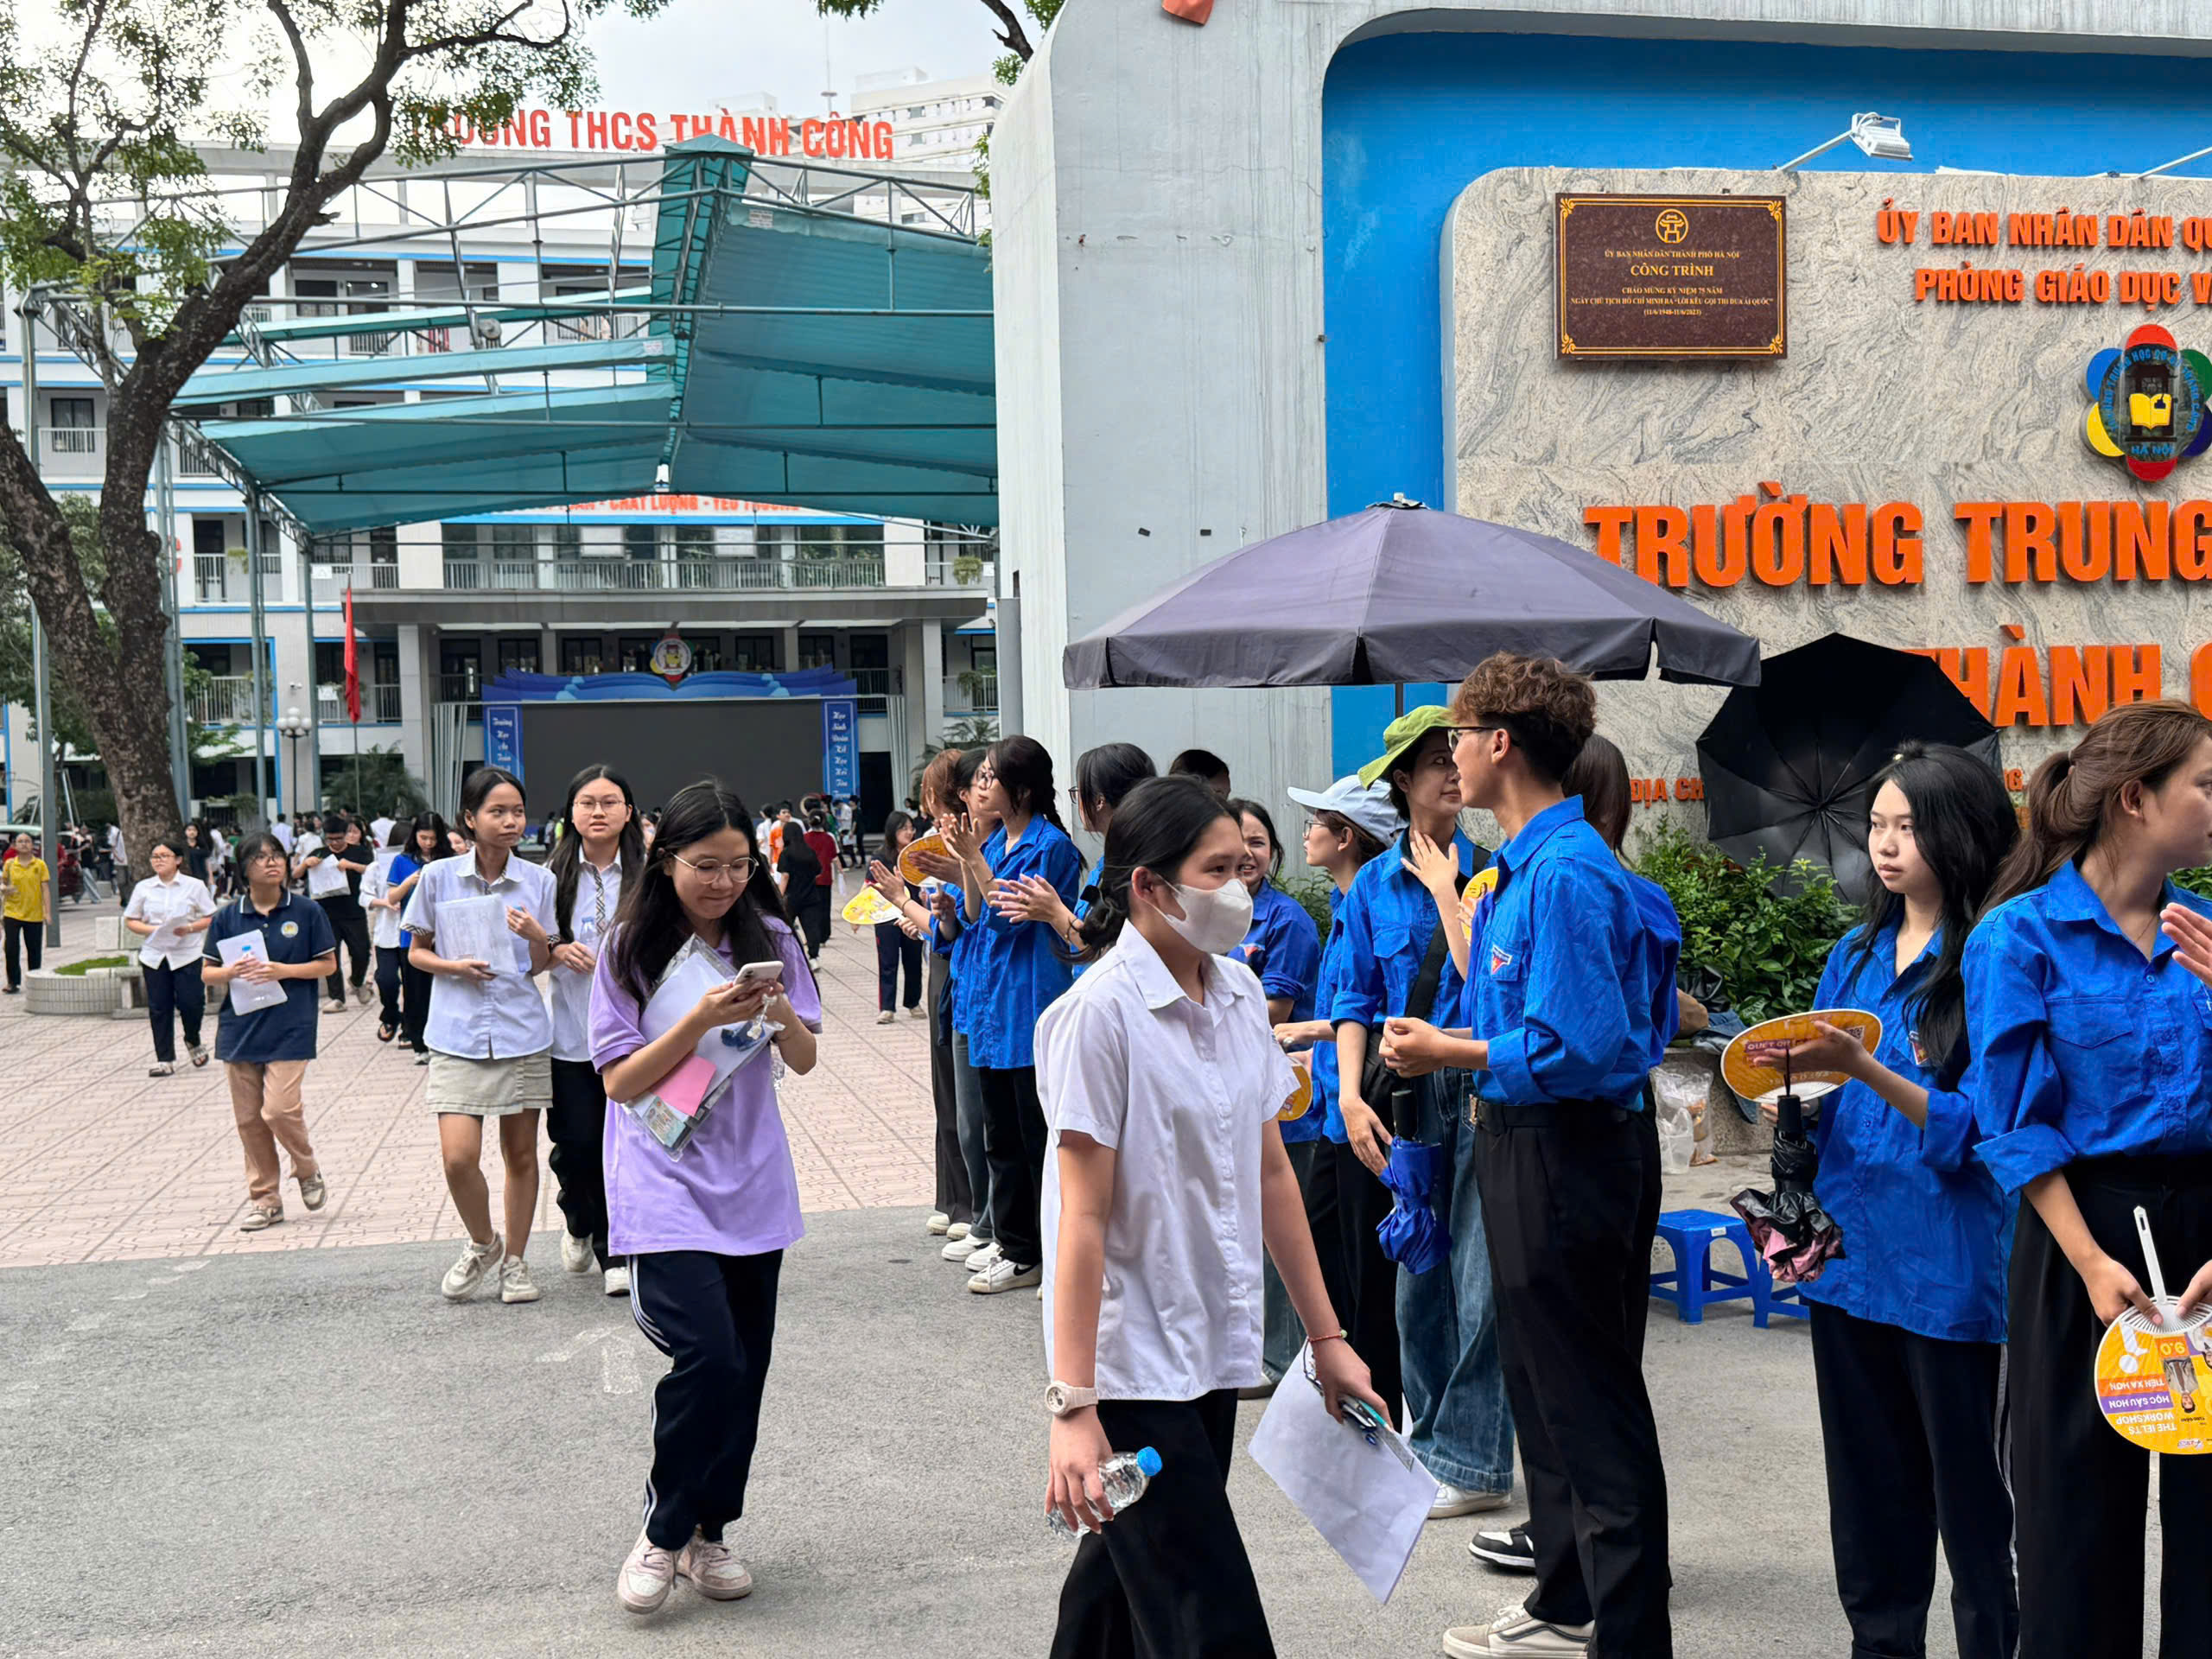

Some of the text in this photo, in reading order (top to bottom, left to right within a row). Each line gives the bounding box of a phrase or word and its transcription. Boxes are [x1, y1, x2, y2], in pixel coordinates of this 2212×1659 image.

[566, 111, 658, 152] THCS
[670, 107, 789, 156] THÀNH
[802, 111, 893, 160] CÔNG
[1876, 197, 1919, 244] ỦY
[1931, 211, 1999, 245] BAN
[2008, 207, 2099, 246] NHÂN
[2107, 207, 2174, 248] DÂN
[1617, 250, 1631, 258] BAN
[1632, 249, 1652, 258] NHÂN
[1654, 249, 1669, 258] DÂN
[1672, 249, 1696, 258] THÀNH
[1697, 248, 1713, 258] PHỐ
[1714, 249, 1726, 258] HÀ
[1630, 262, 1714, 276] CÔNG TRÌNH
[1915, 261, 2212, 311] PHÒNG GIÁO DỤC V
[1583, 480, 2212, 588] TRƯỜNG TRUNG
[1887, 624, 2162, 728] HÀNH
[1675, 778, 1705, 801] CH
[2159, 1341, 2186, 1355] 9.0
[2131, 1380, 2144, 1389] XA
[2130, 1396, 2148, 1408] SÂU
[2149, 1394, 2171, 1405] HỌC
[2115, 1411, 2175, 1425] WORKSHOP
[2128, 1422, 2177, 1435] THE IELTS
